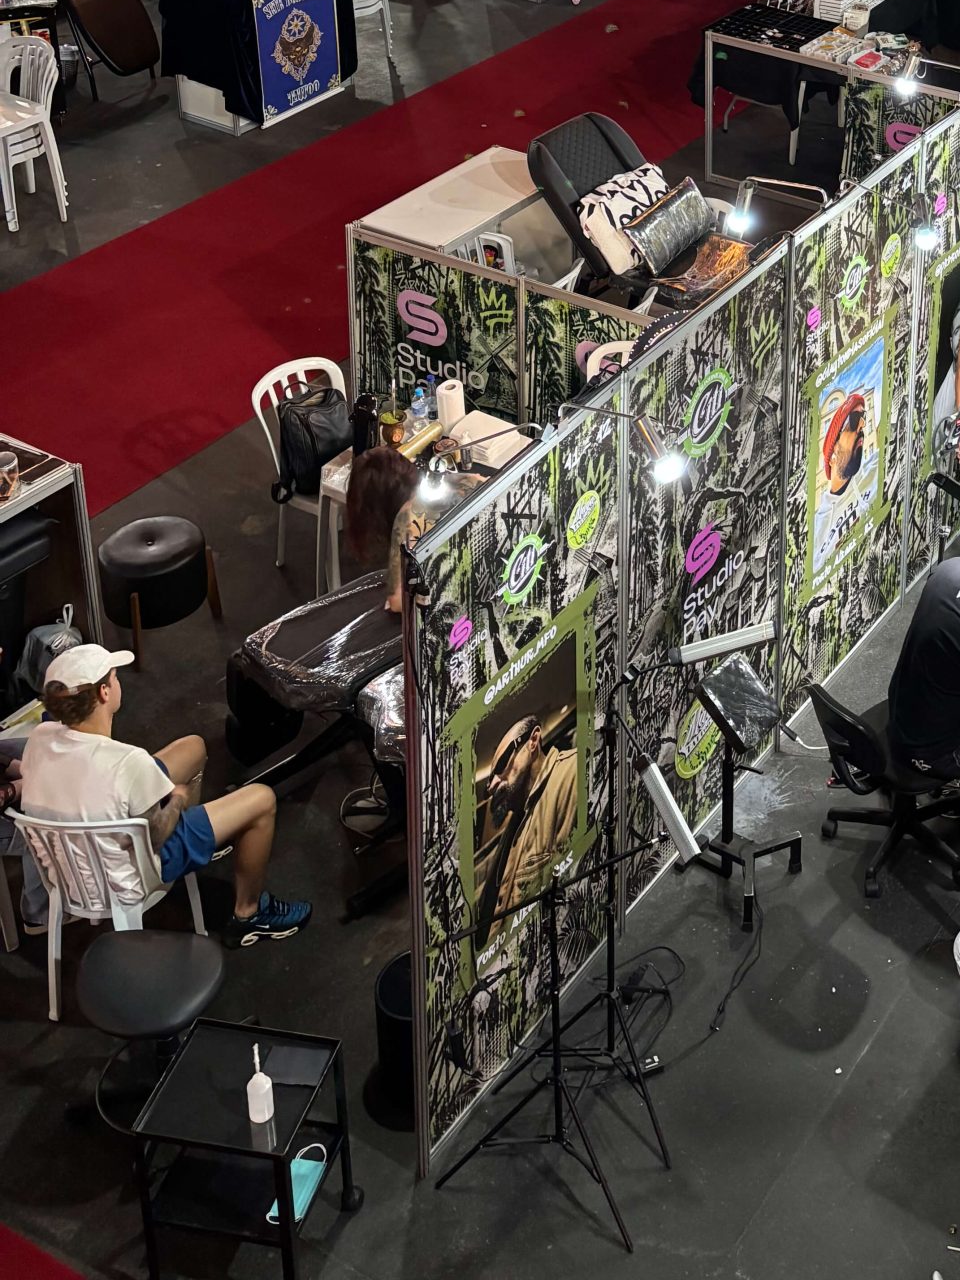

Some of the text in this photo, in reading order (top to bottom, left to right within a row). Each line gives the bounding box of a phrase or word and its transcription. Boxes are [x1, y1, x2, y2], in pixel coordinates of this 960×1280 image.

[396, 342, 487, 391] Studio
[399, 366, 430, 390] Pa
[683, 548, 744, 620] Studio
[683, 597, 720, 646] Pay
[450, 626, 488, 670] Studio
